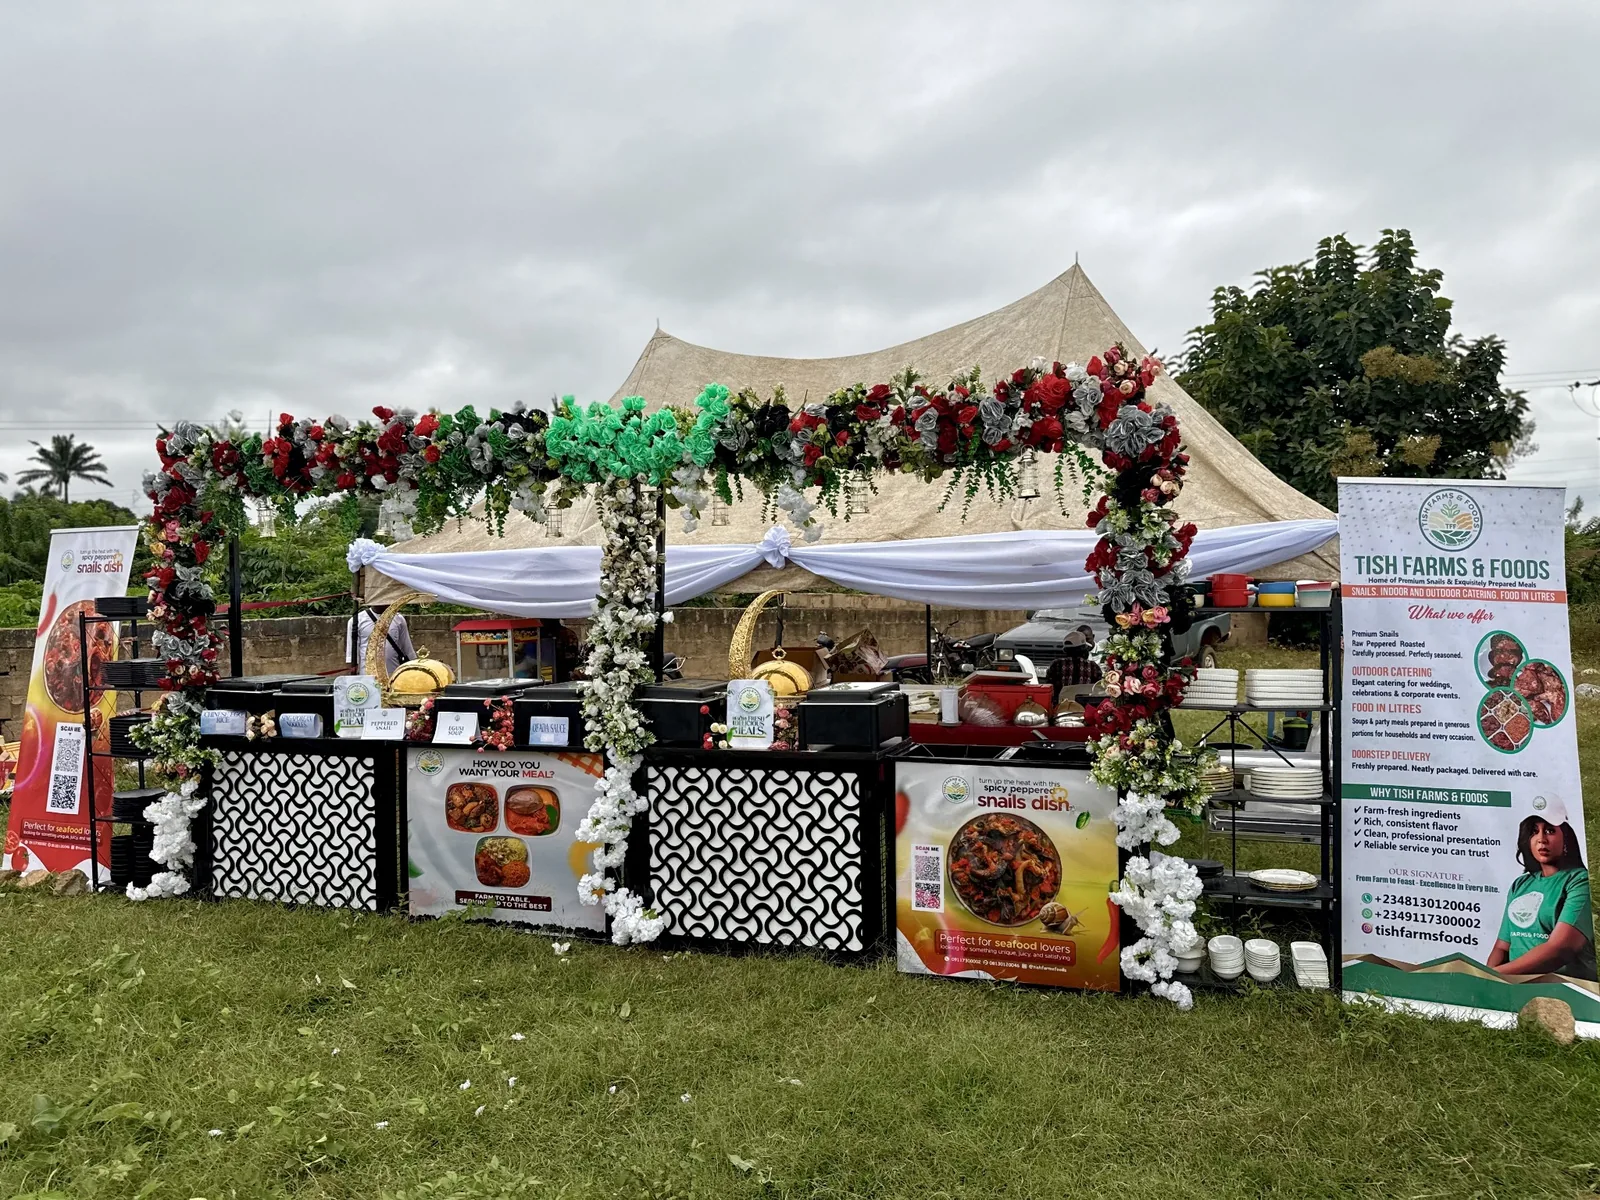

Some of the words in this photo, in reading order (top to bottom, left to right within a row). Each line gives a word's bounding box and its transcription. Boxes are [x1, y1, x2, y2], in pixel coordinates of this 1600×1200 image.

[1427, 493, 1454, 508] FARMS
[1464, 499, 1479, 529] FOODS
[77, 561, 102, 573] snails
[104, 561, 123, 572] dish
[1354, 555, 1398, 574] TISH
[1403, 556, 1467, 576] FARMS
[1472, 558, 1484, 577] &
[1490, 559, 1550, 580] FOODS
[1352, 587, 1378, 595] SNAILS.
[1381, 588, 1408, 596] INDOOR
[1410, 588, 1424, 596] AND
[1426, 588, 1460, 598] OUTDOOR
[1463, 590, 1499, 599] CATERING.
[1501, 591, 1520, 600] FOOD
[1522, 592, 1529, 600] IN
[1531, 592, 1555, 601] LITRES
[1408, 604, 1446, 620] What
[1467, 609, 1494, 624] offer
[1352, 650, 1374, 658] Carefully
[1409, 651, 1432, 659] Perfectly
[1352, 666, 1388, 676] OUTDOOR
[1391, 667, 1432, 677] CATERING
[1420, 681, 1452, 689] weddings,
[1352, 703, 1373, 712] FOOD
[1377, 703, 1386, 712] IN
[1389, 704, 1422, 714] LITRES
[550, 724, 566, 733] SAUCE
[1352, 750, 1390, 759] DOORSTEP
[1392, 751, 1430, 761] DELIVERY
[1352, 762, 1375, 771] Freshly
[1412, 765, 1434, 774] Neatly
[1437, 767, 1470, 775] packaged.
[984, 784, 1007, 792] spicy
[978, 793, 1026, 809] snails
[1032, 796, 1070, 811] dish
[1370, 788, 1391, 797] WHY
[1393, 788, 1414, 799] TISH
[1417, 790, 1449, 801] FARMS
[1451, 792, 1458, 802] &
[1461, 792, 1488, 803] FOODS
[1364, 806, 1408, 816] Farm-fresh
[1412, 808, 1461, 819] ingredients
[24, 822, 46, 831] Perfect
[56, 826, 83, 834] seafood
[1364, 818, 1383, 827] Rich,
[1386, 820, 1430, 829] consistent
[1432, 822, 1458, 831] flavor
[1364, 829, 1388, 839] Clean,
[1391, 832, 1444, 842] professional
[1447, 837, 1500, 846] presentation
[1364, 841, 1396, 850] Reliable
[1399, 843, 1429, 853] service
[1432, 848, 1447, 856] you
[1468, 849, 1489, 857] trust
[1389, 868, 1408, 876] OUR
[1411, 870, 1464, 881] SIGNATURE
[1420, 880, 1456, 889] Excellence
[1465, 884, 1483, 892] Every
[1485, 885, 1500, 893] Bite.
[1375, 894, 1480, 912] +2348130120046
[1375, 910, 1480, 928] +2349117300002
[1375, 925, 1478, 946] tishfarmsfoods
[940, 934, 975, 945] Perfect
[979, 937, 992, 946] for
[995, 940, 1037, 950] seafood
[1040, 943, 1071, 953] lovers
